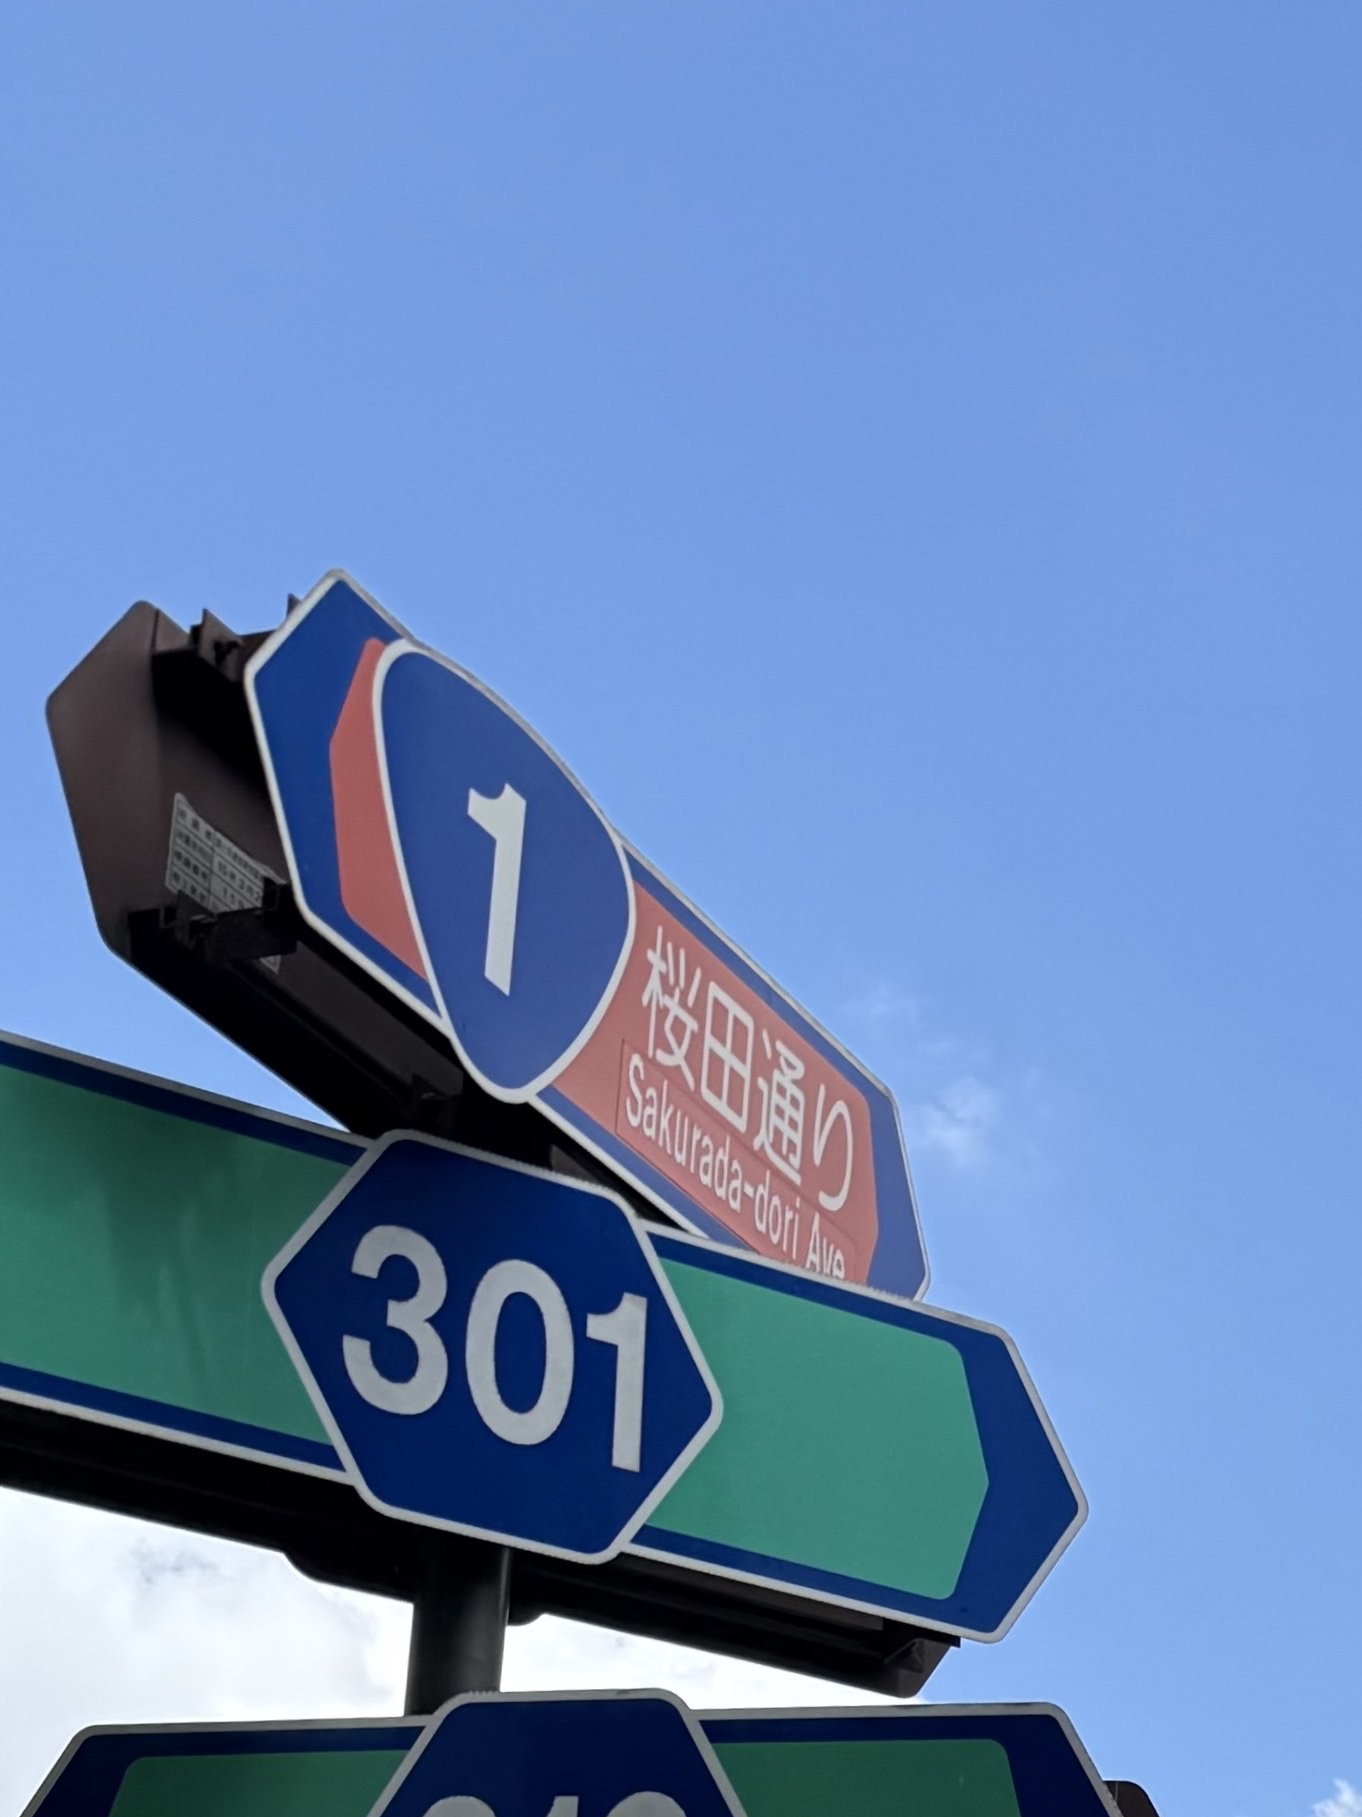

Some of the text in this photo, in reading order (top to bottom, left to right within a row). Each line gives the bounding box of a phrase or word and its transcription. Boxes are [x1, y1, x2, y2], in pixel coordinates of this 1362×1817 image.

[467, 782, 527, 997] 1
[624, 1052, 801, 1262] Sakurada-dori
[641, 924, 854, 1212] 桜田通り
[342, 1224, 648, 1473] 301
